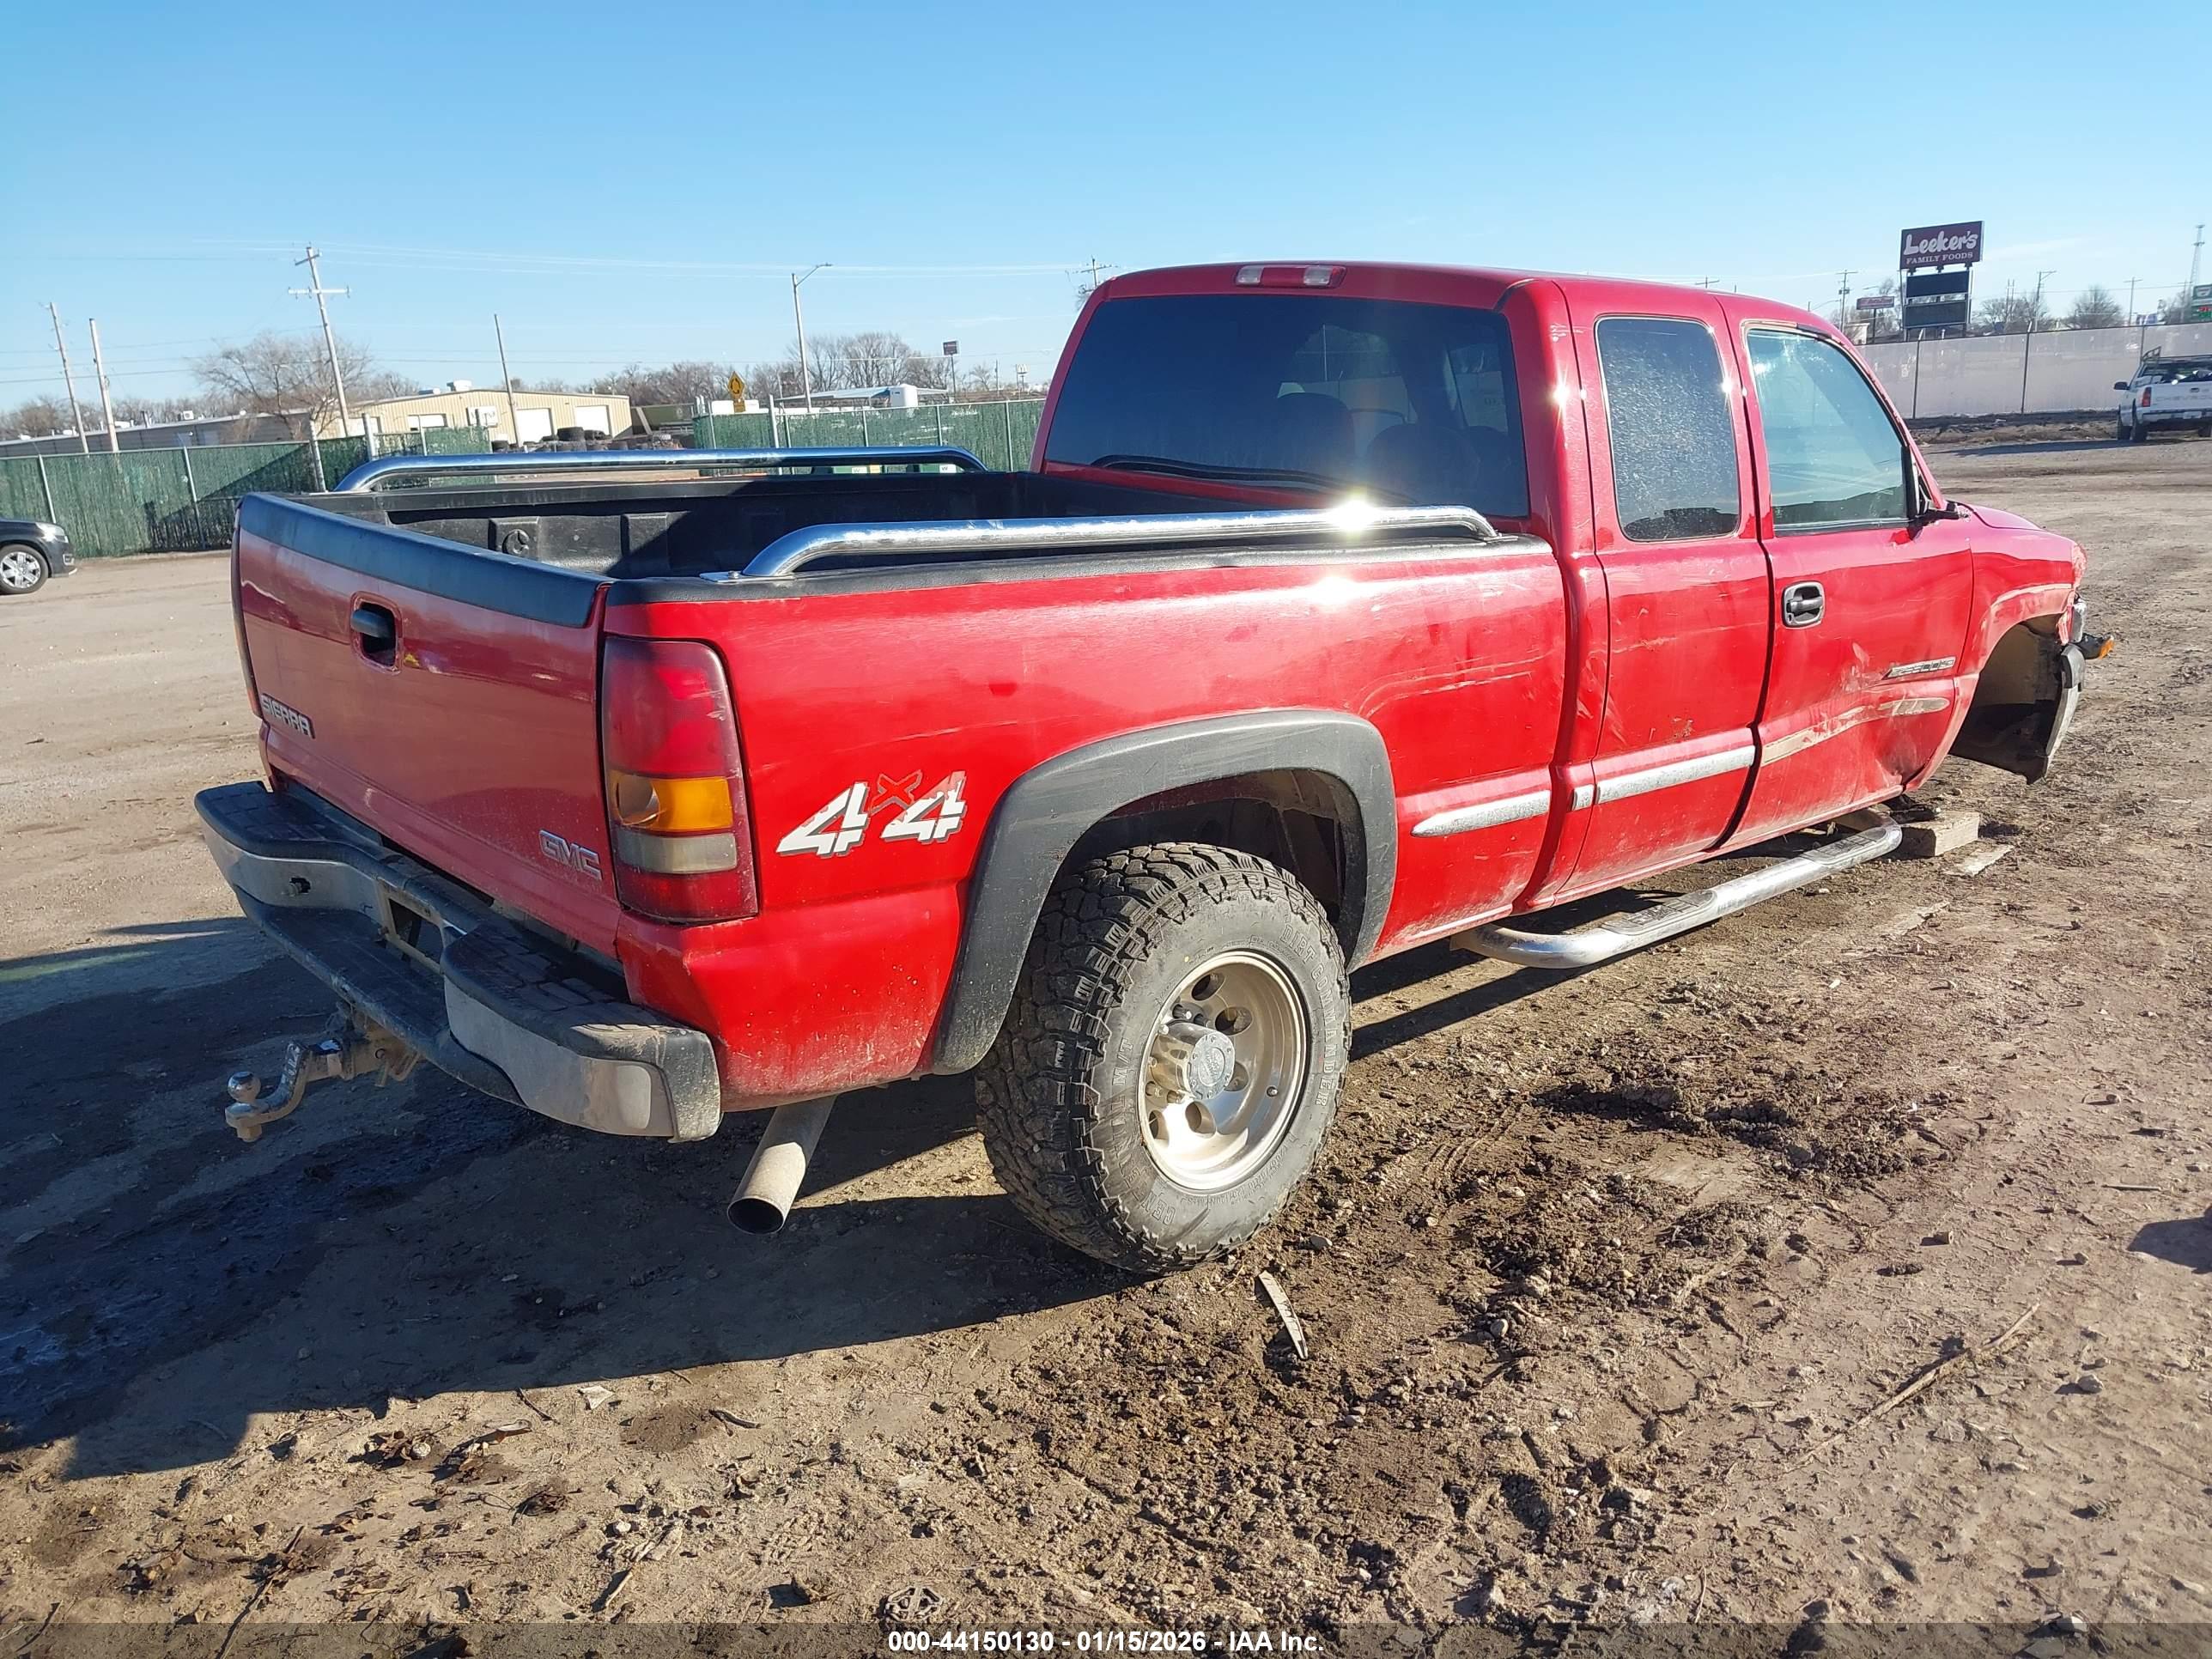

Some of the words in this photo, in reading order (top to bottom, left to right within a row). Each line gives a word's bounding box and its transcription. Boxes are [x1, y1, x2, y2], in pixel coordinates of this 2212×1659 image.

[1903, 230, 1978, 255] Leeker's
[1905, 255, 1941, 264] FAMILY
[1942, 252, 1973, 261] FOODS
[261, 694, 313, 738] SIERRA
[538, 829, 603, 881] GMC
[1279, 923, 1316, 964] DIRT
[1310, 963, 1338, 1107] COMMANDER
[1112, 1037, 1133, 1086] M/T
